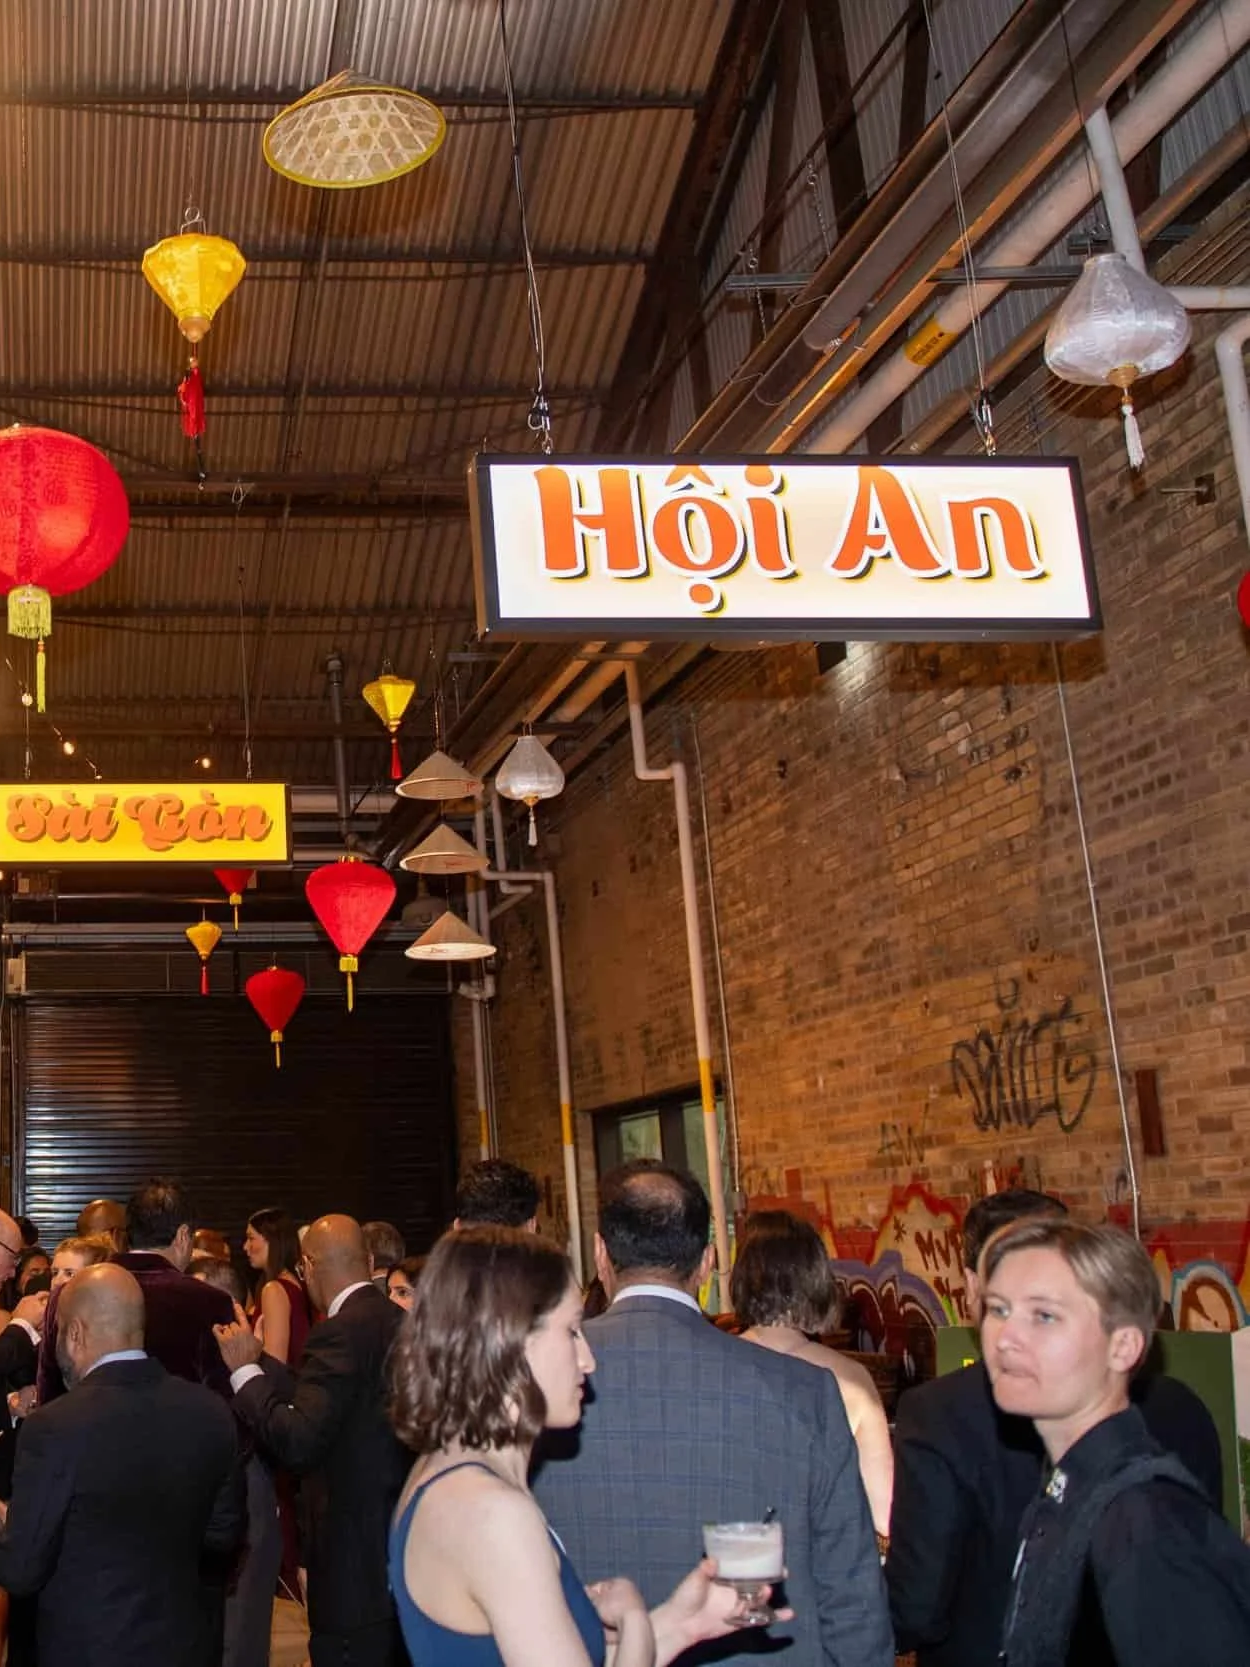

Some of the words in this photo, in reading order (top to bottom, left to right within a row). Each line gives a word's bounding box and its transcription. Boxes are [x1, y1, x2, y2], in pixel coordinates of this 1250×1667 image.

[534, 464, 799, 618] Hội
[827, 464, 1053, 582] An
[6, 790, 119, 842] Sài
